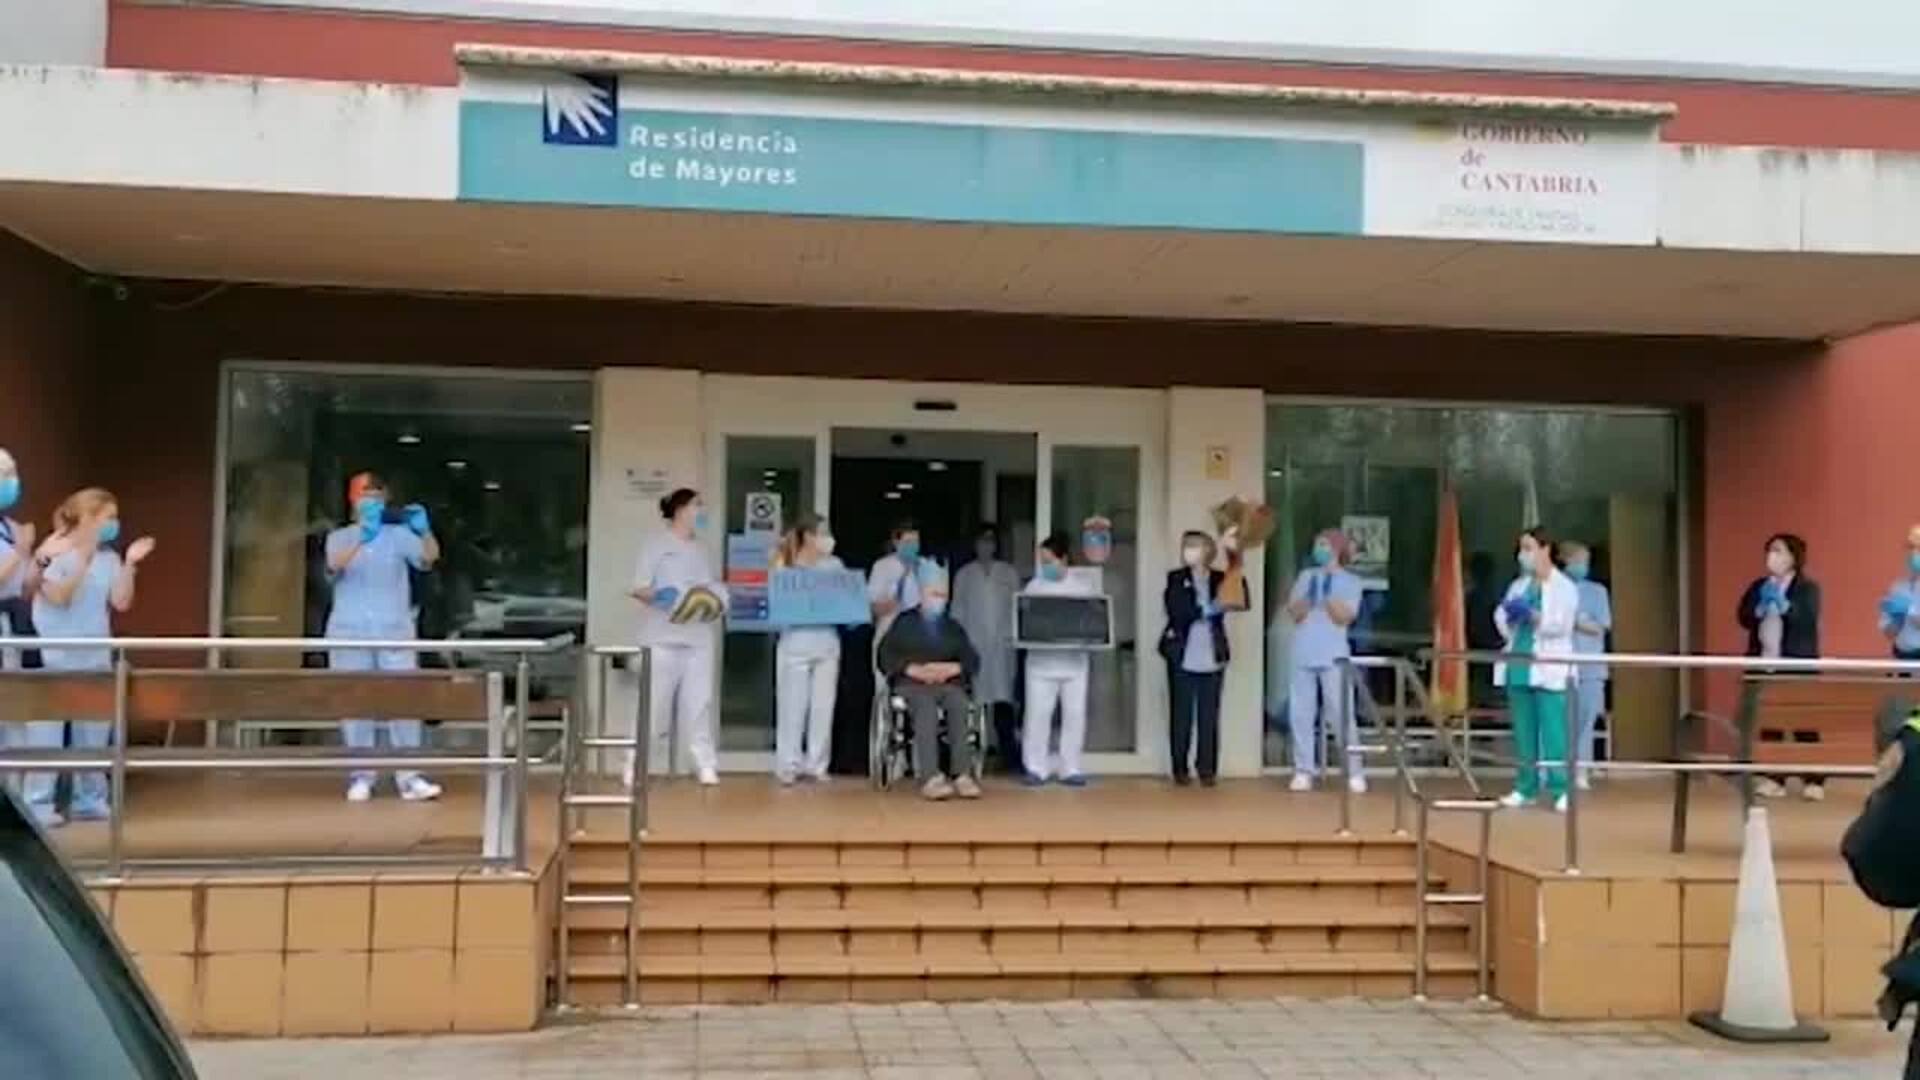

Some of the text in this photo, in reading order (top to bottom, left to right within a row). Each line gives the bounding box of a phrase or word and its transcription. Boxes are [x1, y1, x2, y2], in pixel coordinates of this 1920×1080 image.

[630, 125, 797, 153] Residencia
[1462, 124, 1590, 145] GOBIERNO
[1459, 148, 1486, 167] de
[629, 156, 796, 187] de Mayores
[1461, 172, 1599, 195] CANTABRIA
